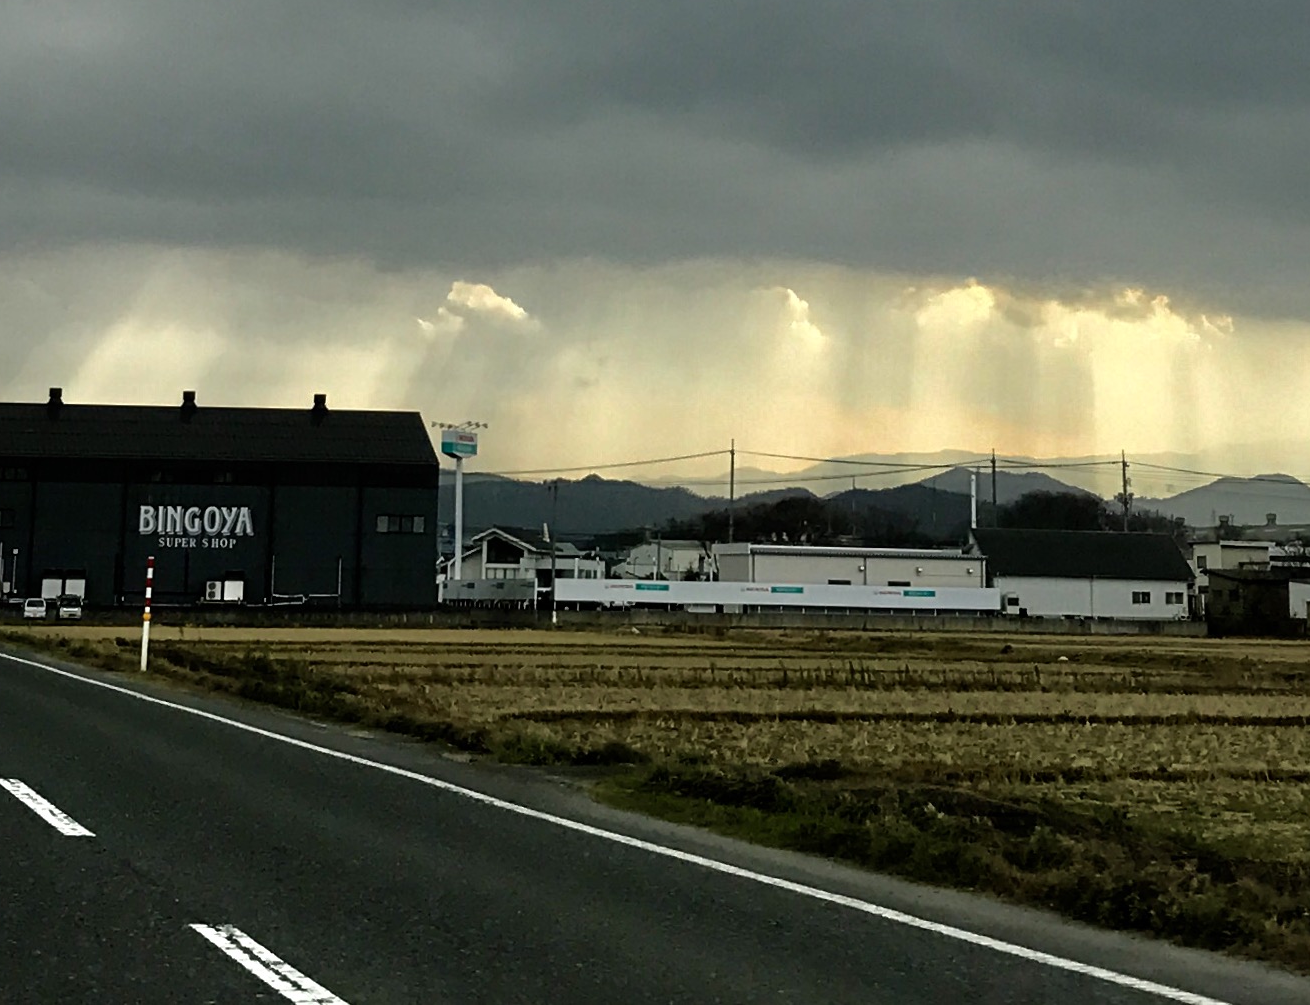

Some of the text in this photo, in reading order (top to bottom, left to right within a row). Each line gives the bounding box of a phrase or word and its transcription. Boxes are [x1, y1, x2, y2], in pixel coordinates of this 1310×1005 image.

[139, 505, 254, 536] BINGOYA
[158, 537, 237, 549] SUPER SHOP
